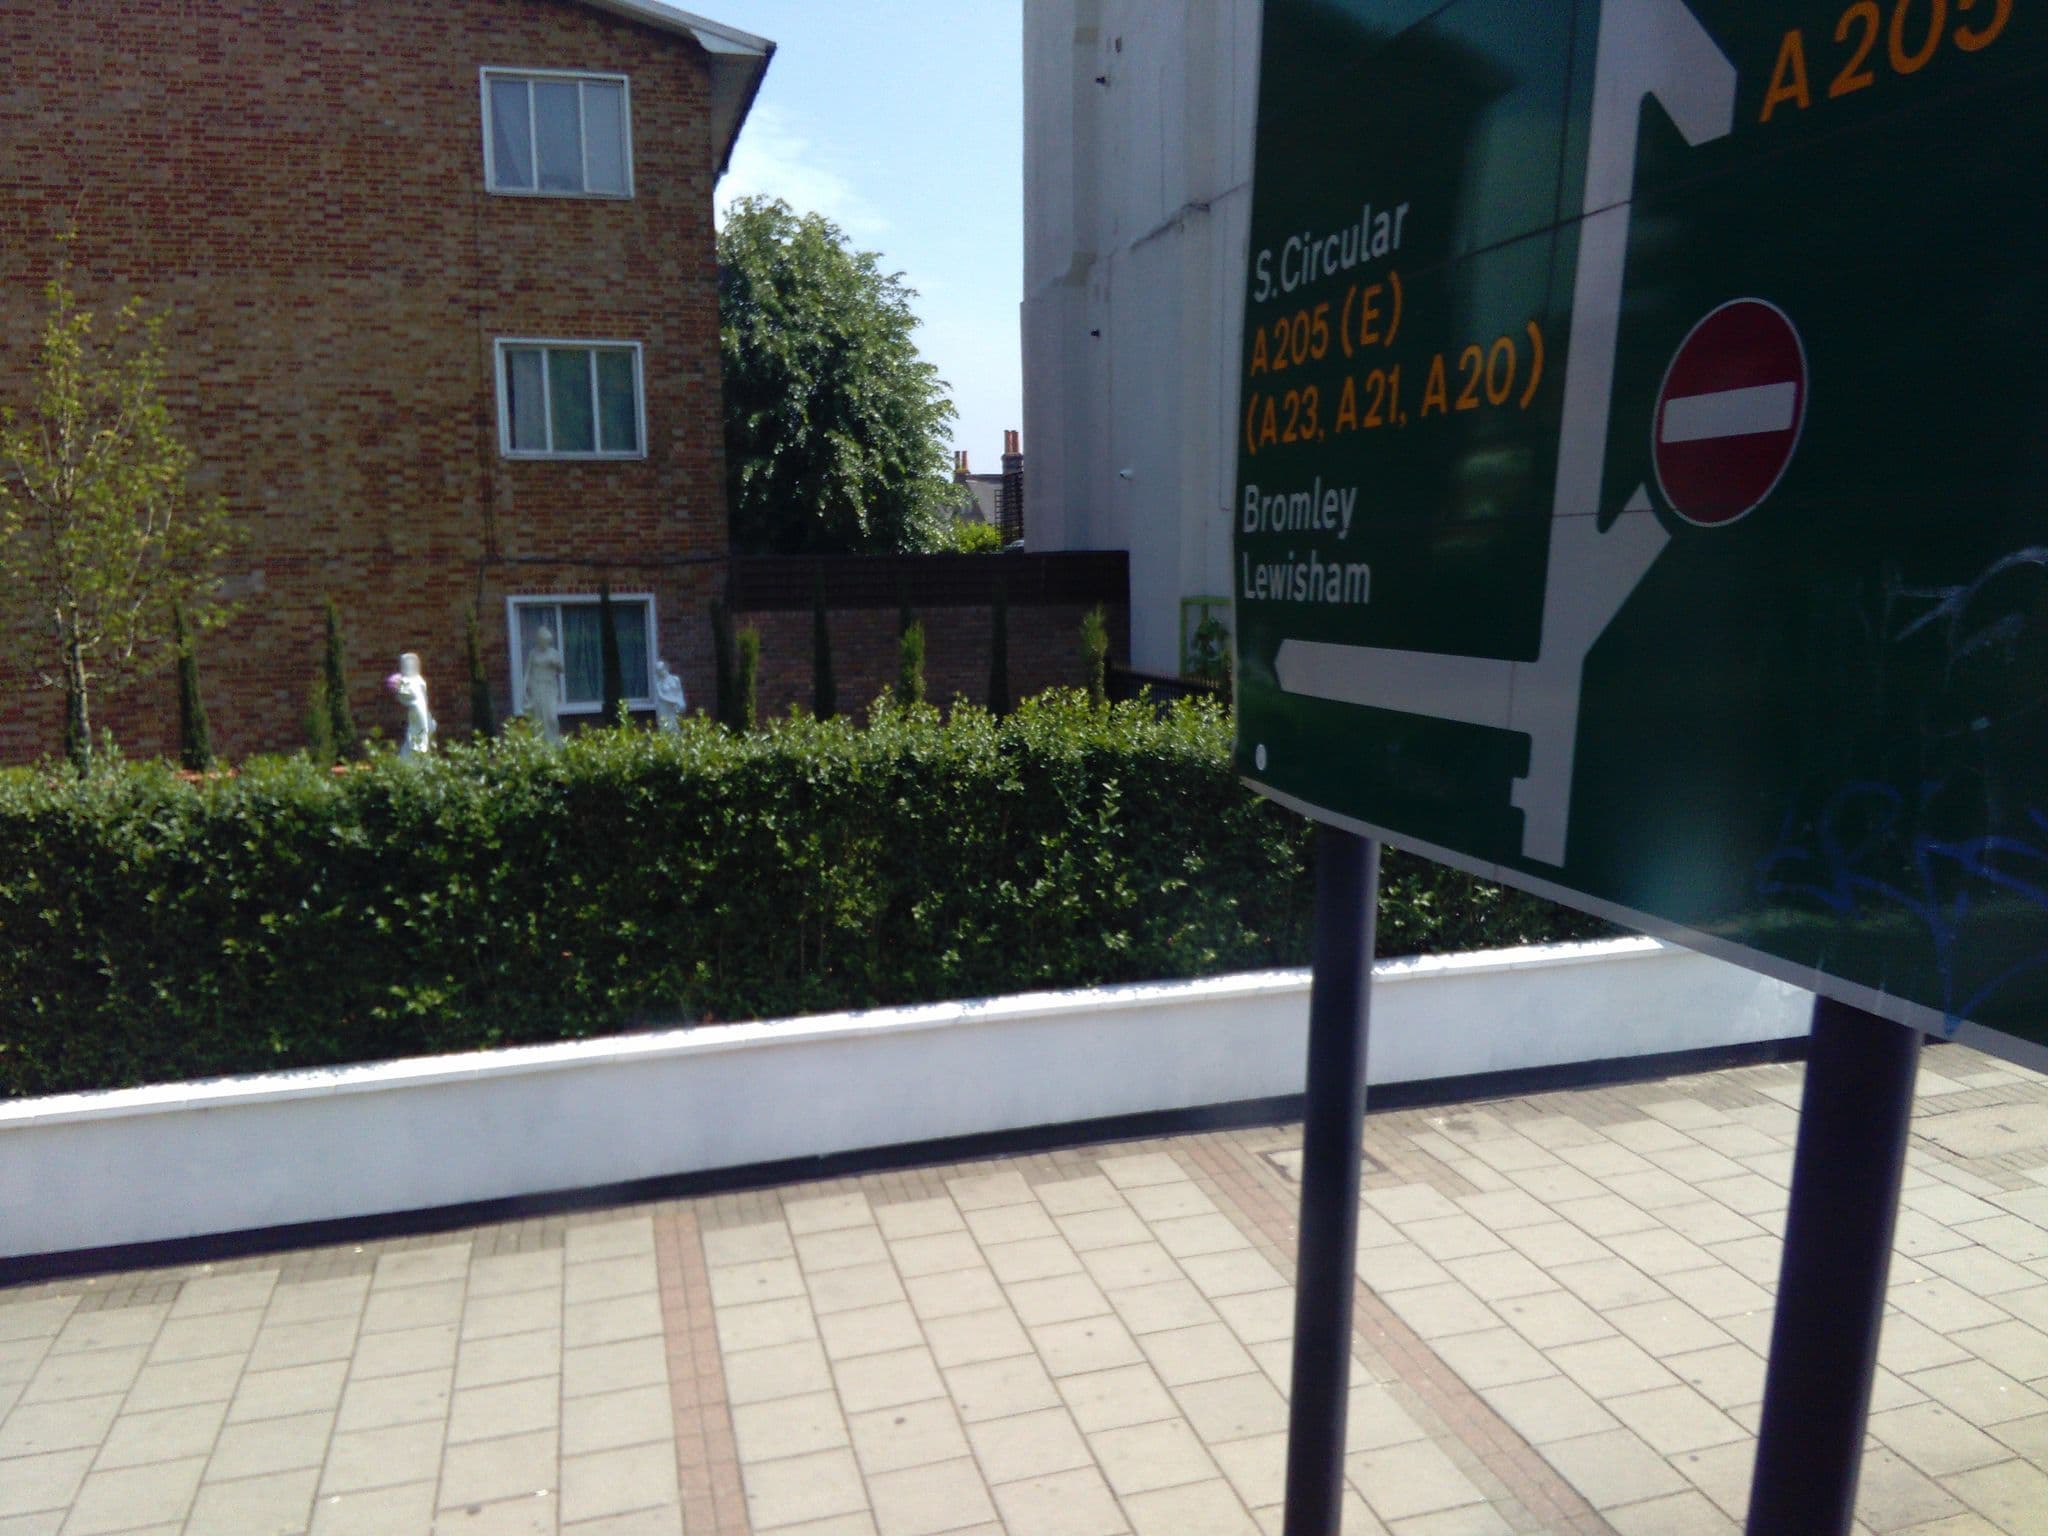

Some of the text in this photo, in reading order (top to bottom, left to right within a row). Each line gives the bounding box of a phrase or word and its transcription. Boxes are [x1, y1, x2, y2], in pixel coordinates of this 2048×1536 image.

[1250, 270, 1401, 377] A205 (E)
[1419, 319, 1544, 417] A20)
[1243, 476, 1358, 540] Bromley
[1243, 550, 1371, 604] Lewisham
